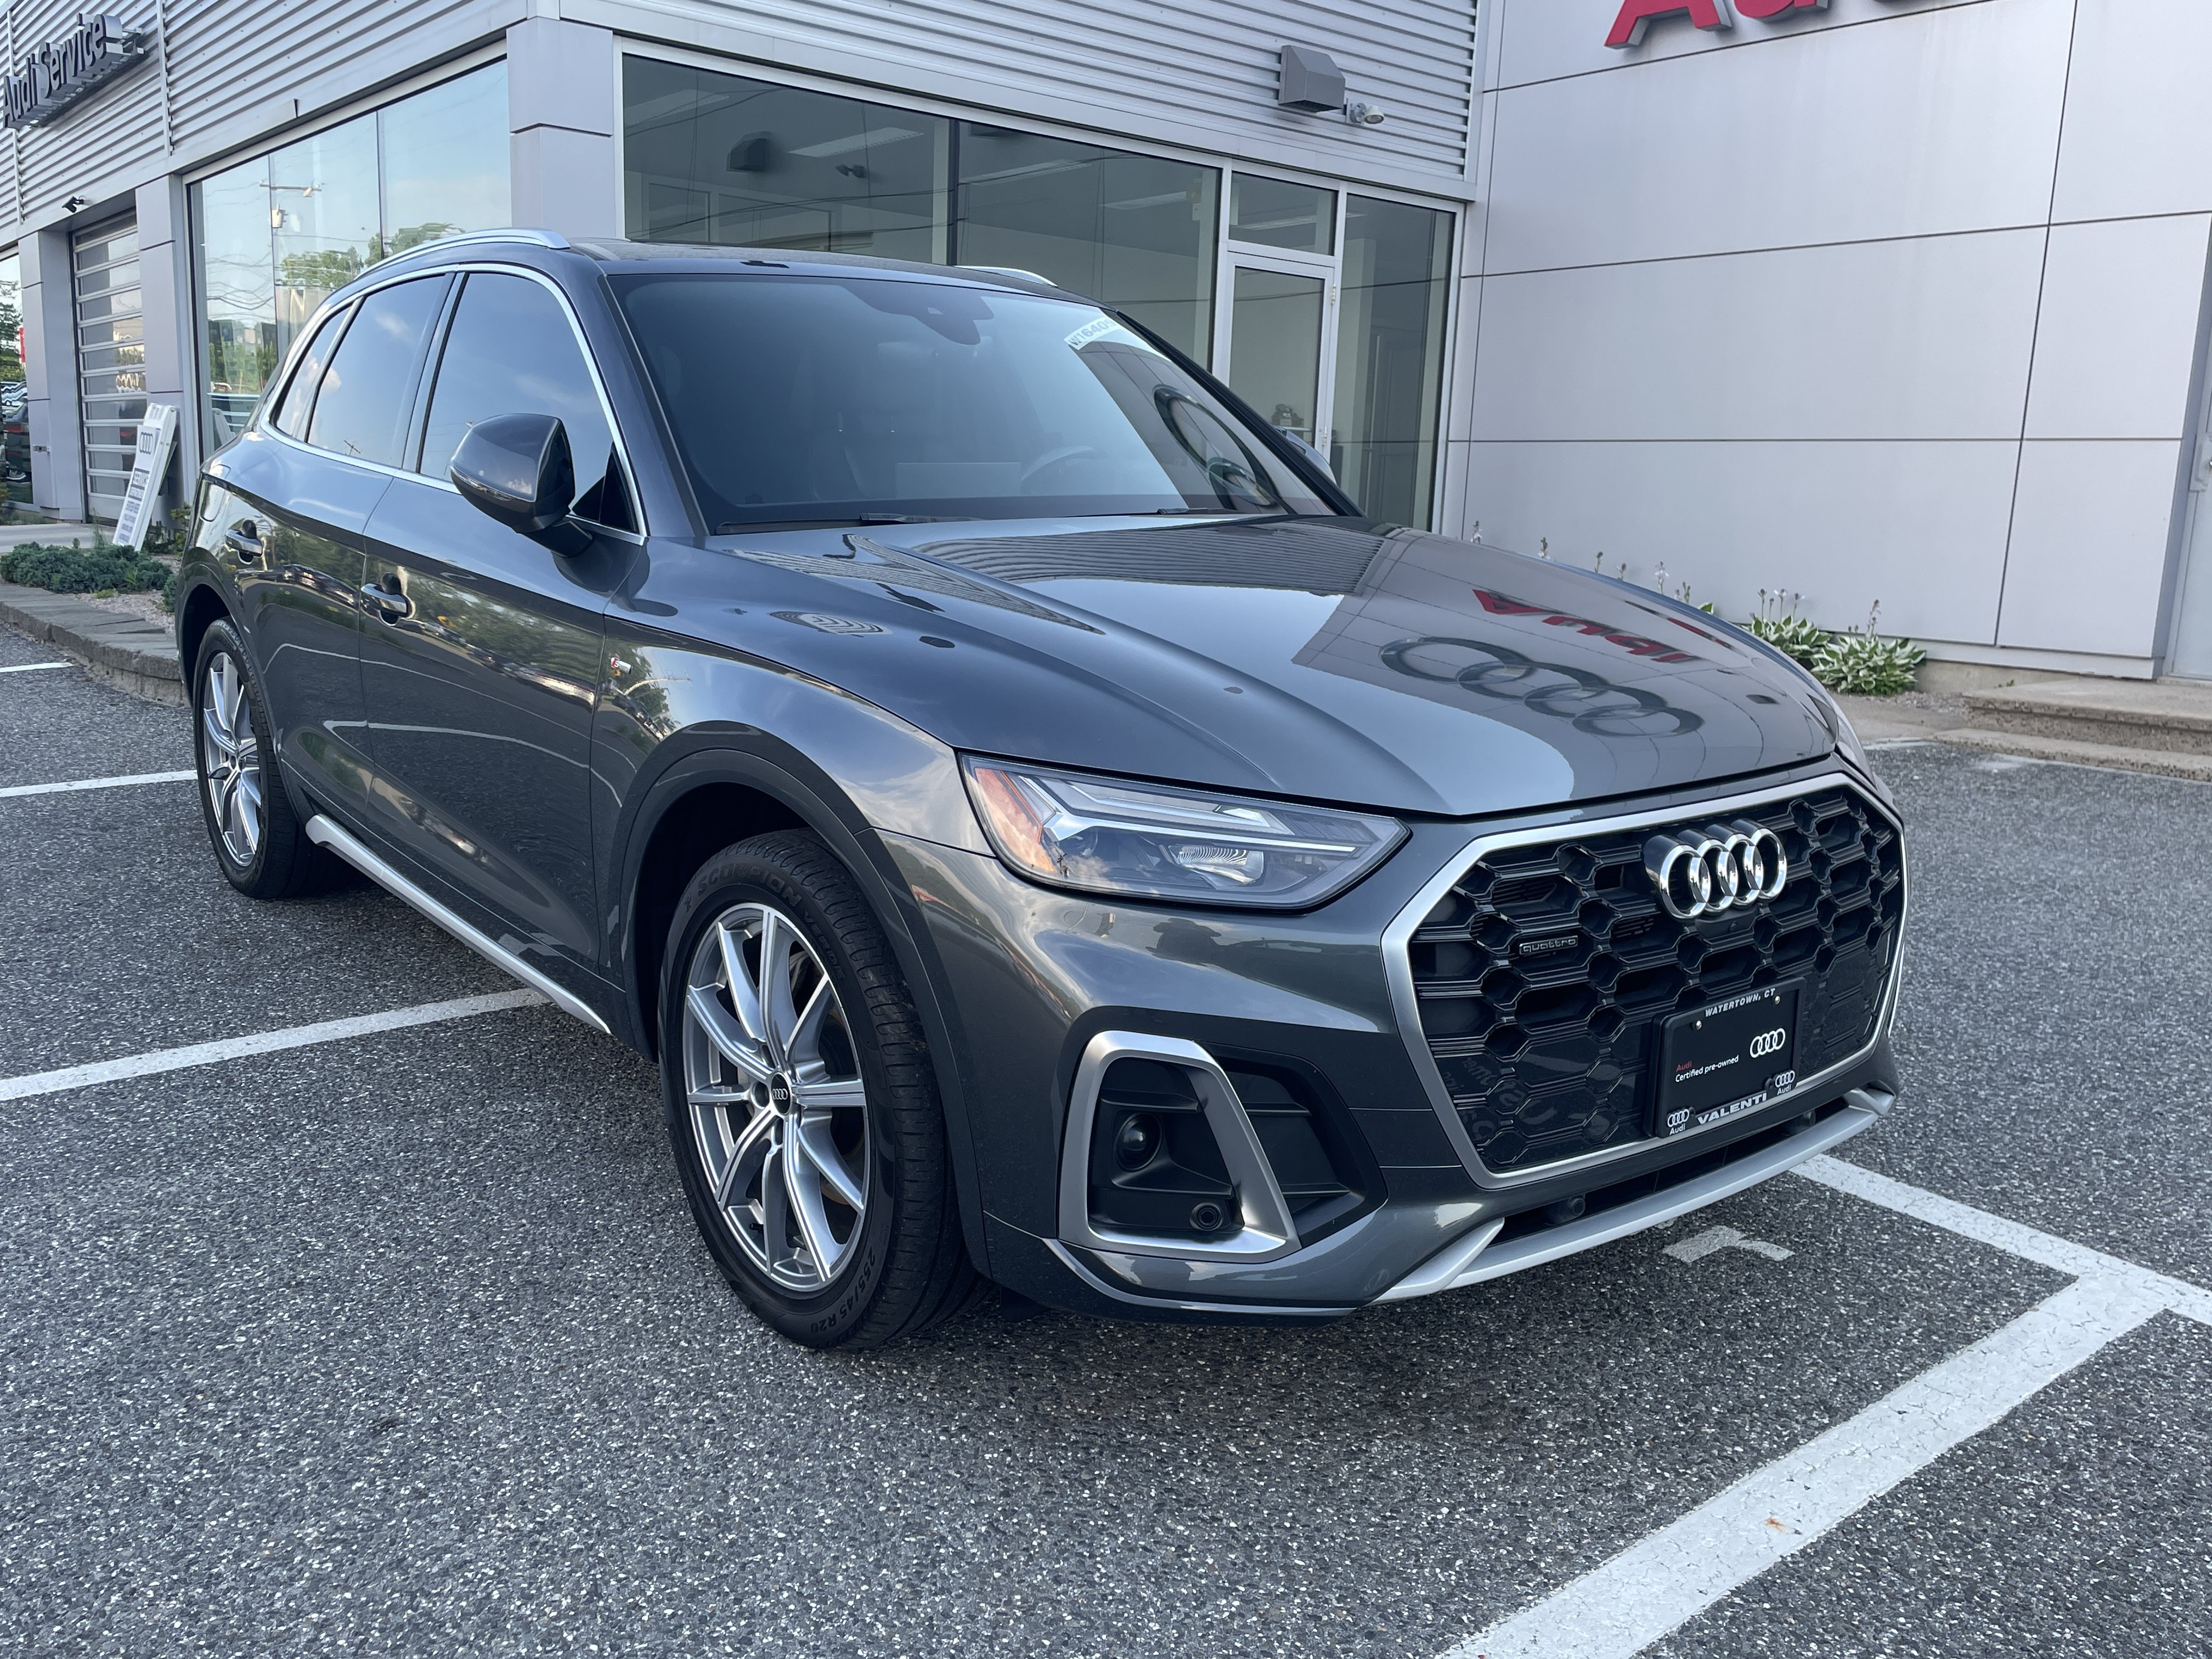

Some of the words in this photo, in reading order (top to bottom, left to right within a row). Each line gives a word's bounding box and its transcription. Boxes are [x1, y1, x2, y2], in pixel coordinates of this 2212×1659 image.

[698, 862, 802, 907] SCORPION
[805, 910, 845, 980] VERDE
[1523, 939, 1576, 953] quattro
[1705, 992, 1761, 1017] WATERTOWN,
[1764, 988, 1775, 998] CT
[1675, 1065, 1703, 1082] Certified
[1705, 1054, 1739, 1074] pre-owned
[1676, 1060, 1692, 1072] Audi
[1777, 1085, 1792, 1096] Audi
[1697, 1092, 1767, 1125] VALENTI
[1669, 1123, 1686, 1136] Audi
[810, 1313, 837, 1334] R20
